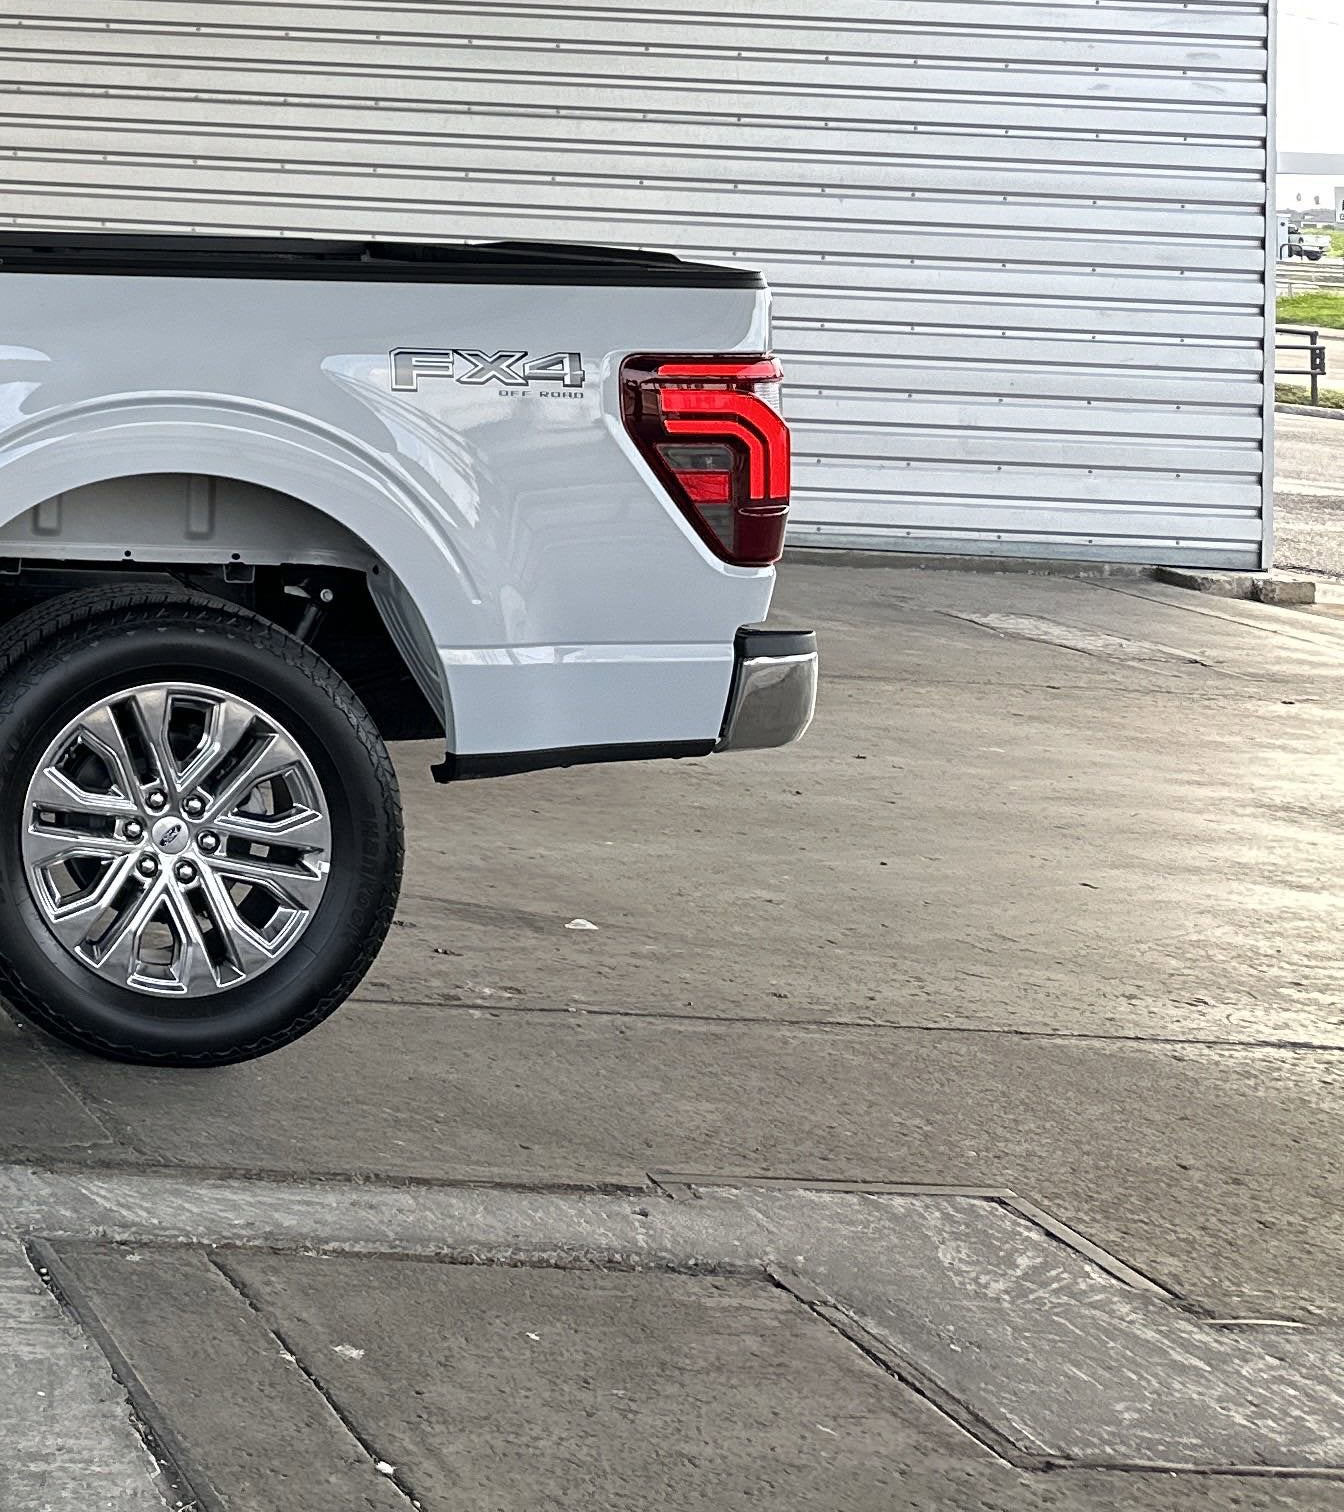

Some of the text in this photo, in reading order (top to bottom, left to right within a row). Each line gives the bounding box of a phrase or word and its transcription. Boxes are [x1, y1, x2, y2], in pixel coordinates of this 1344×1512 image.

[389, 346, 586, 392] FX4
[498, 390, 584, 399] OFF ROAD
